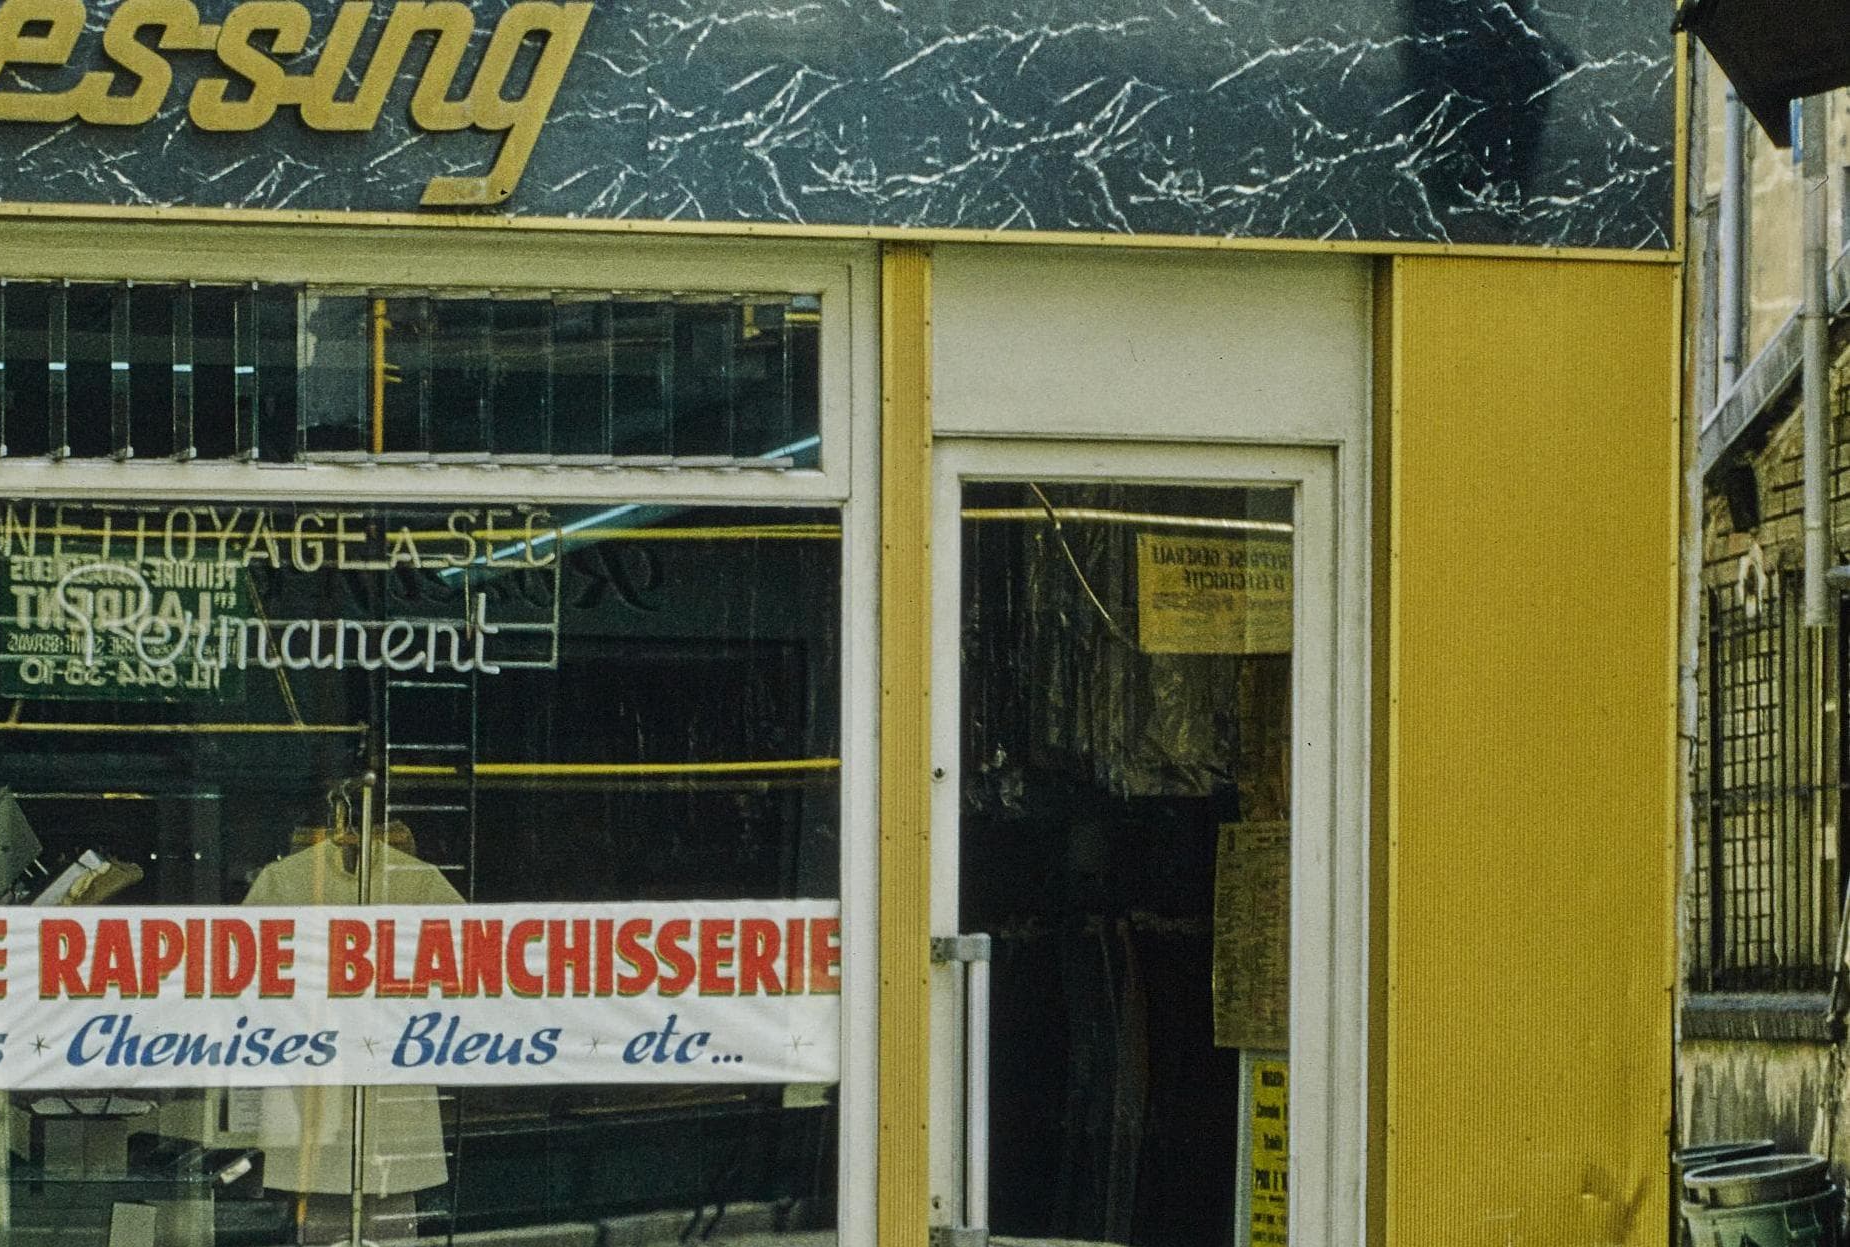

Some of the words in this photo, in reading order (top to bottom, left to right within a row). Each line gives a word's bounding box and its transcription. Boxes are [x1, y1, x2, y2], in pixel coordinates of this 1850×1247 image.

[0, 503, 372, 573] NETTOYAGE
[445, 507, 556, 568] SEC
[59, 564, 500, 674] Permanent
[39, 918, 295, 1000] RAPIDE
[327, 918, 841, 999] BLANCHISSERIE
[66, 1013, 339, 1068] Chemises
[391, 1011, 562, 1067] Bleus
